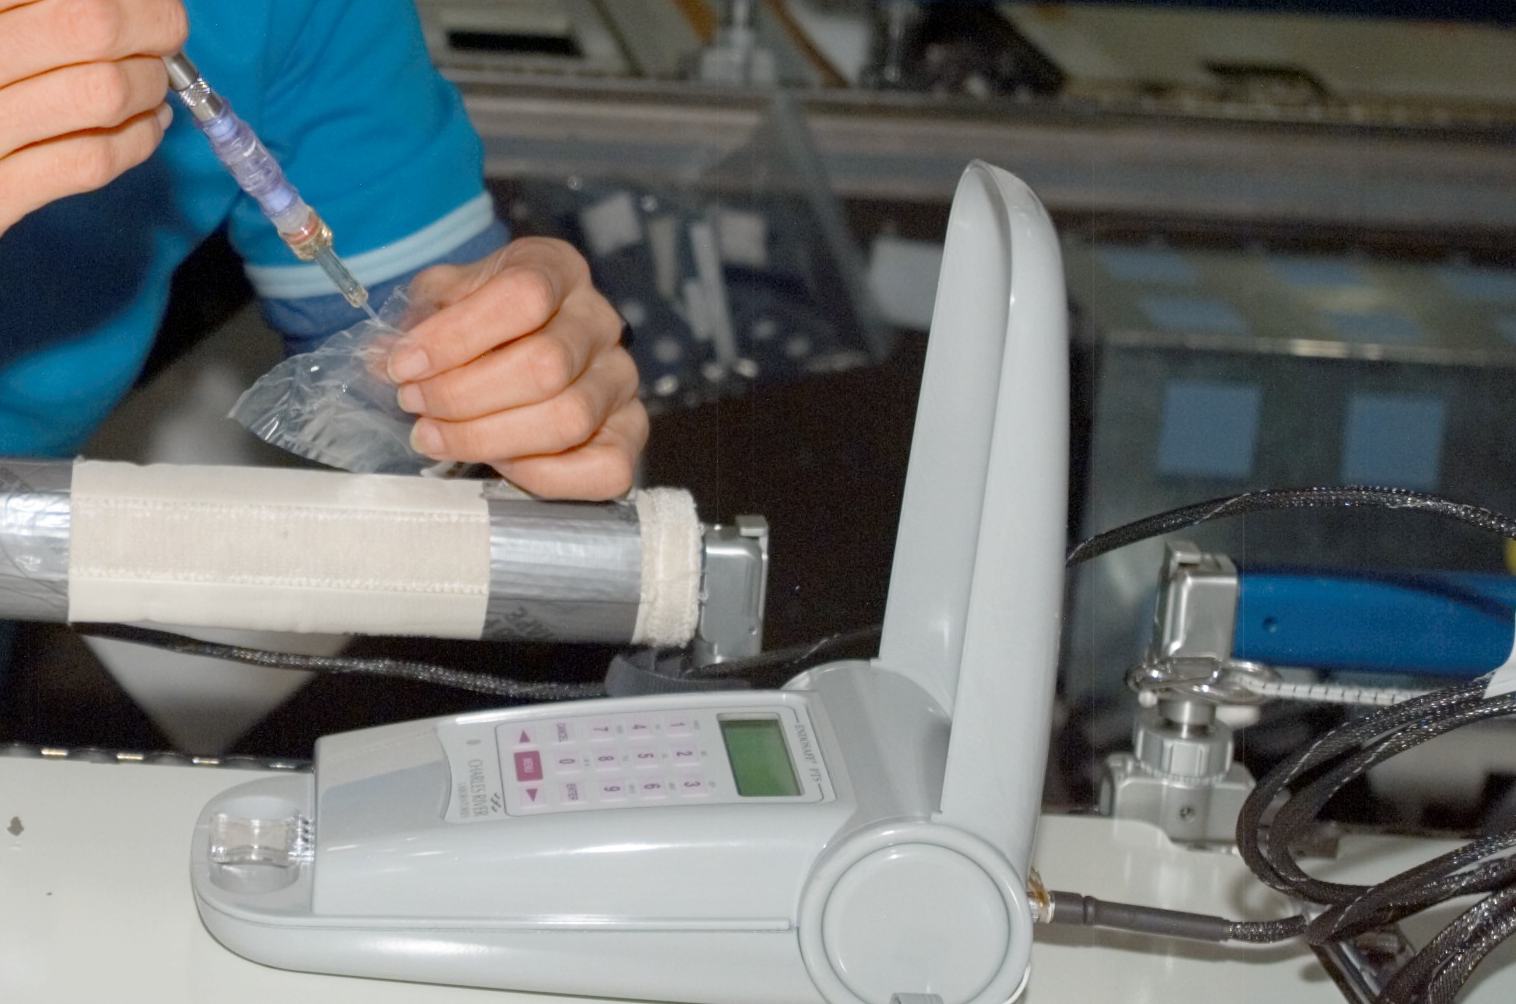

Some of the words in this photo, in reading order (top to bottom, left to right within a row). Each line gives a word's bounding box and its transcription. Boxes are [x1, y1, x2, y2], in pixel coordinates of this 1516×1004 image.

[523, 757, 534, 773] MENU
[556, 722, 569, 743] CANCEL
[566, 783, 579, 801] ENTER
[468, 759, 486, 794] CHARLES
[809, 768, 822, 783] PTS
[472, 794, 489, 817] RIVER
